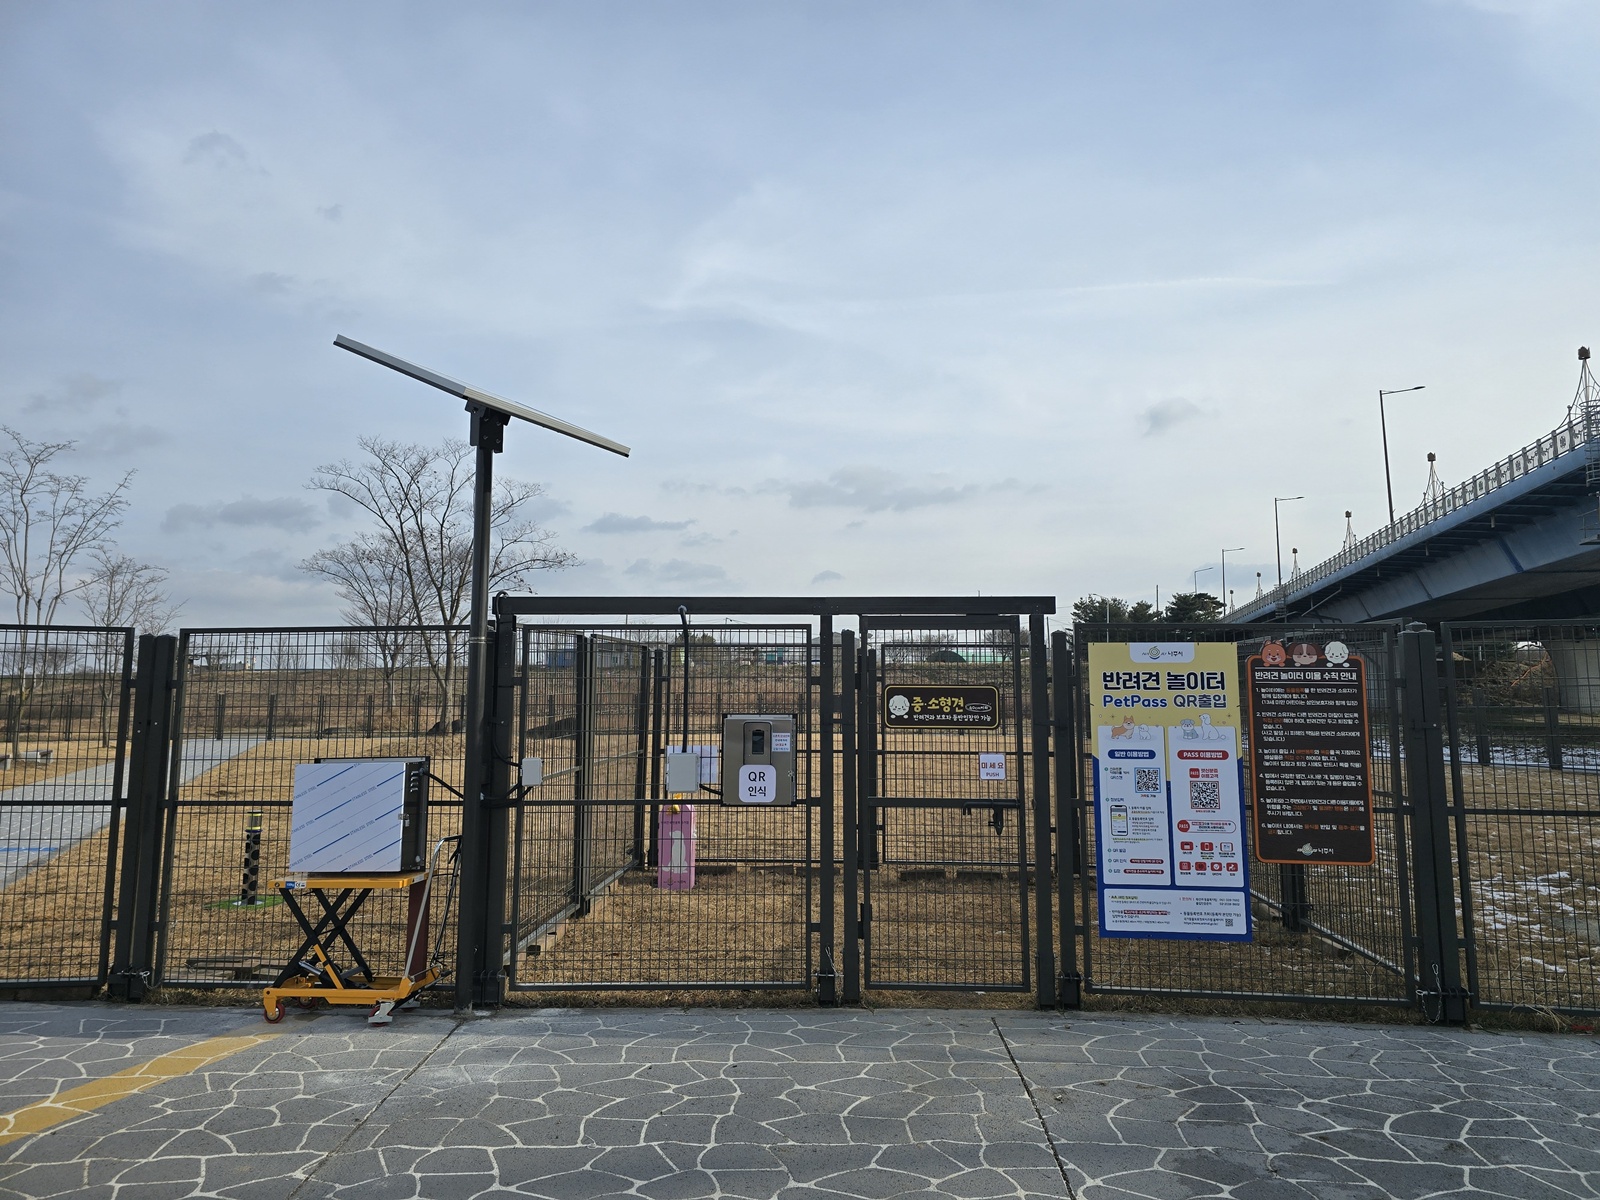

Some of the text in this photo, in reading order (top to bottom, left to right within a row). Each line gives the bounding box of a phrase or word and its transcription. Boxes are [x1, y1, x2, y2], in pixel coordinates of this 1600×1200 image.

[1103, 672, 1225, 690] 반려견 놀이터
[1103, 694, 1226, 708] PetPass QR출입
[748, 772, 766, 782] QR
[748, 786, 766, 797] 인식
